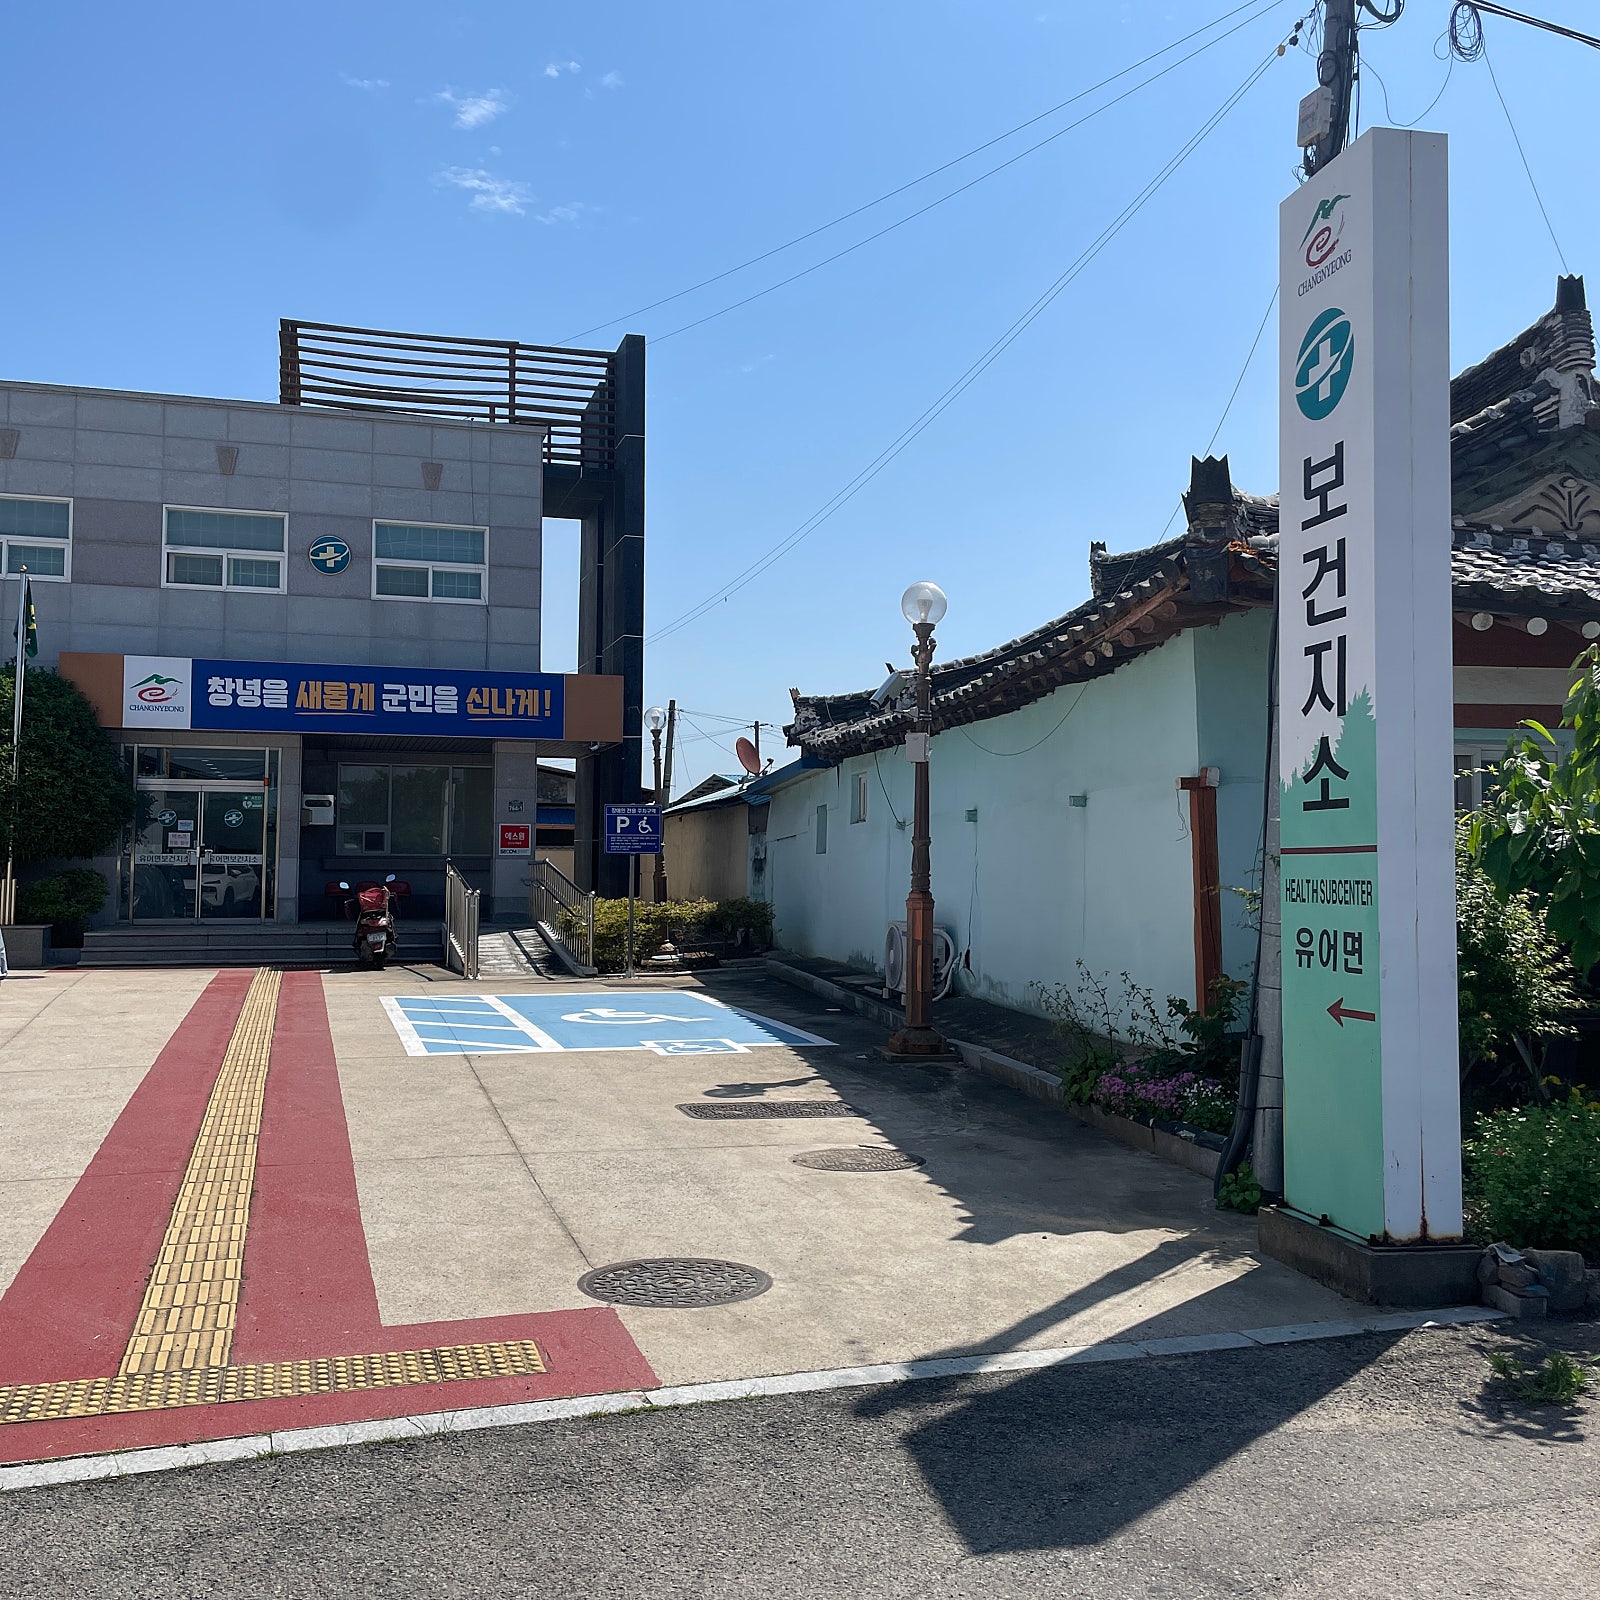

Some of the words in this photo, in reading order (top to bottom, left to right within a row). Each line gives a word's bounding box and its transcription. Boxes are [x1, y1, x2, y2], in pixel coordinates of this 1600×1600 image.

[1297, 249, 1352, 297] CHANGNYEONG
[1301, 440, 1350, 812] 보건지소
[129, 704, 185, 713] CHANGNYEONG
[207, 676, 289, 709] 창녕을
[295, 680, 375, 711] 새롭게
[382, 683, 459, 714] 군민을
[465, 687, 551, 717] 신나게!
[504, 832, 525, 841] 에스원
[616, 816, 630, 834] P
[1295, 927, 1363, 975] 유어면
